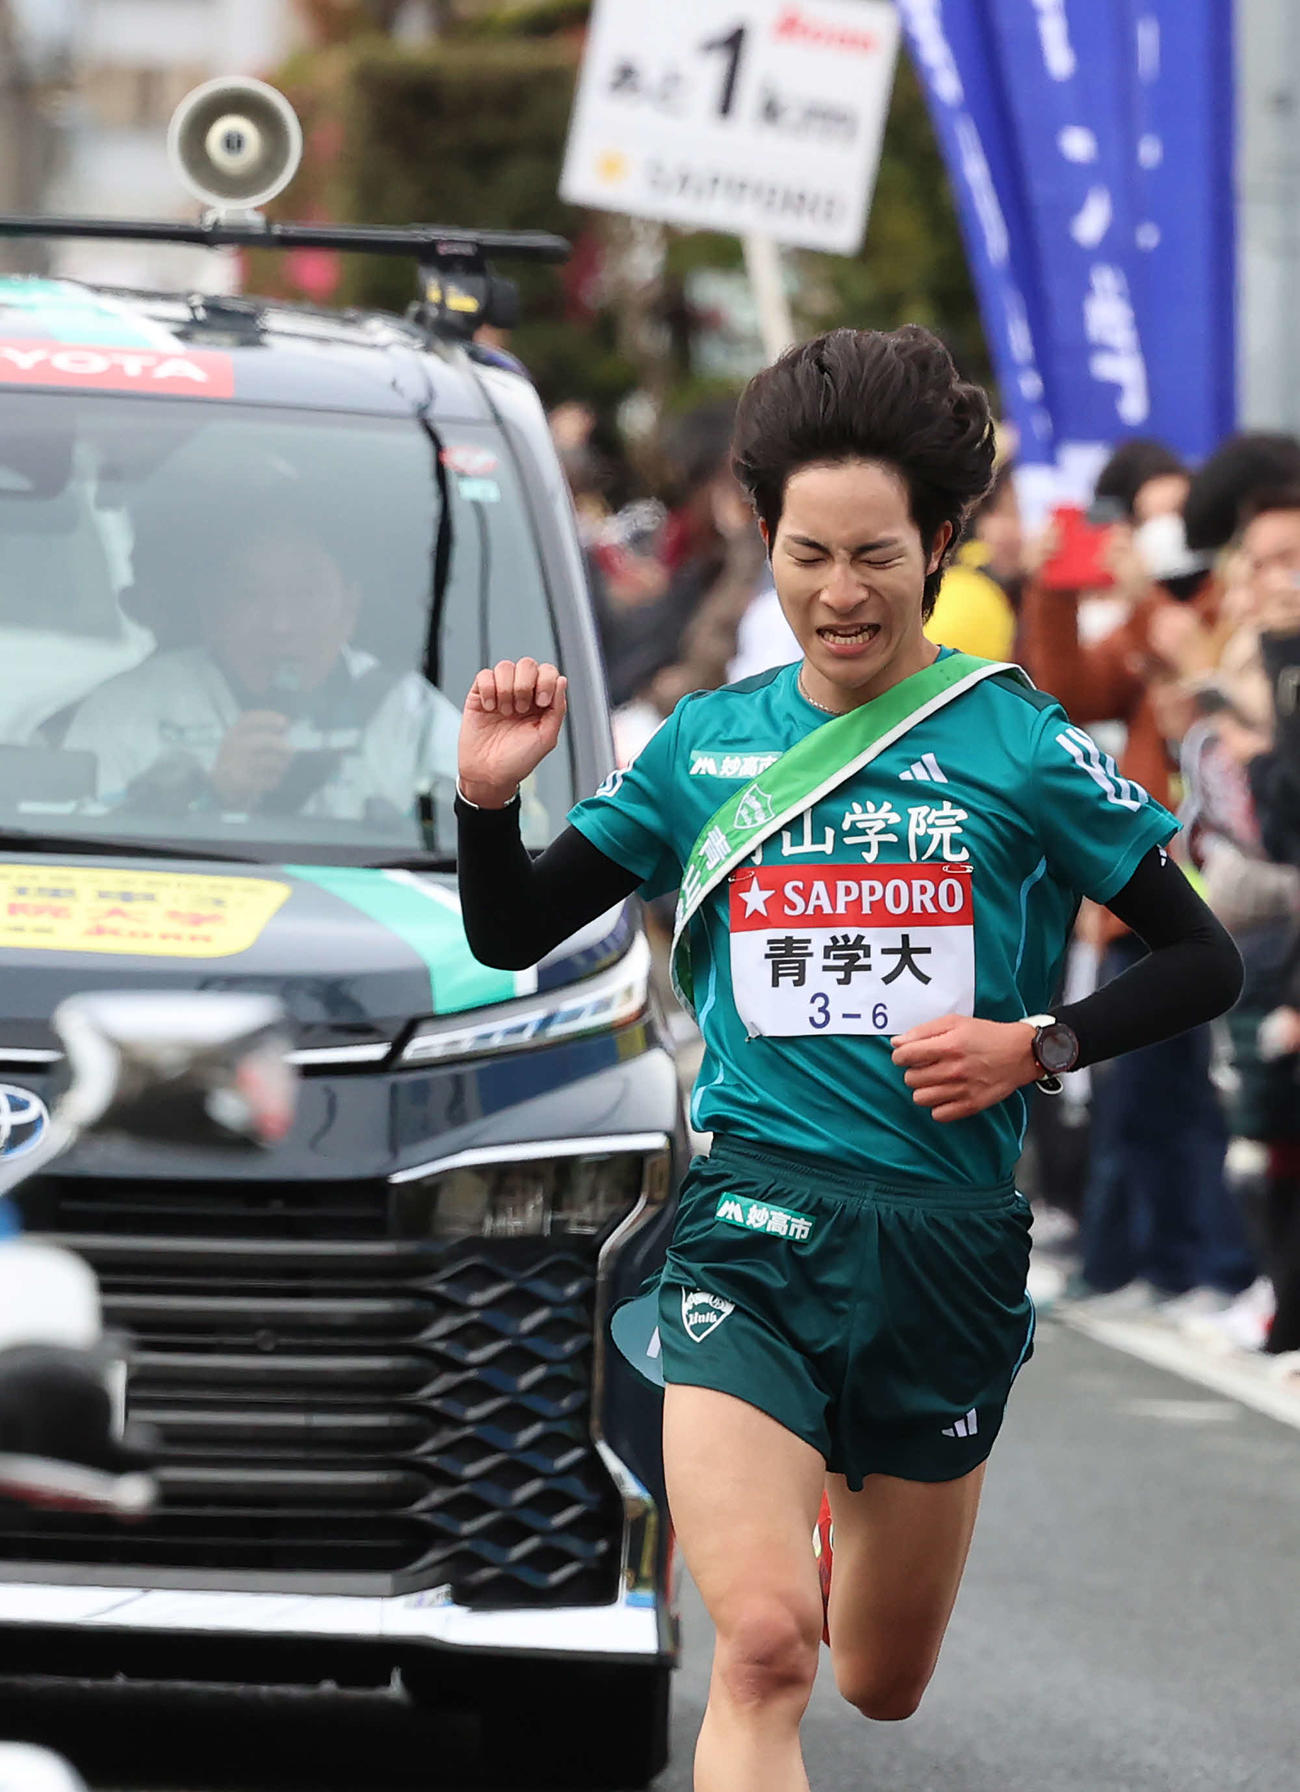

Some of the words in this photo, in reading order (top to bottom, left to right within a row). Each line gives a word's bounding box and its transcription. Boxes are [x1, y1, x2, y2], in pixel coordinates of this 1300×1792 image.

[698, 23, 746, 121] 1
[751, 800, 970, 865] 山学院
[783, 878, 964, 916] SAPPORO
[764, 933, 933, 988] 青学大
[746, 1203, 813, 1240] 妙高市
